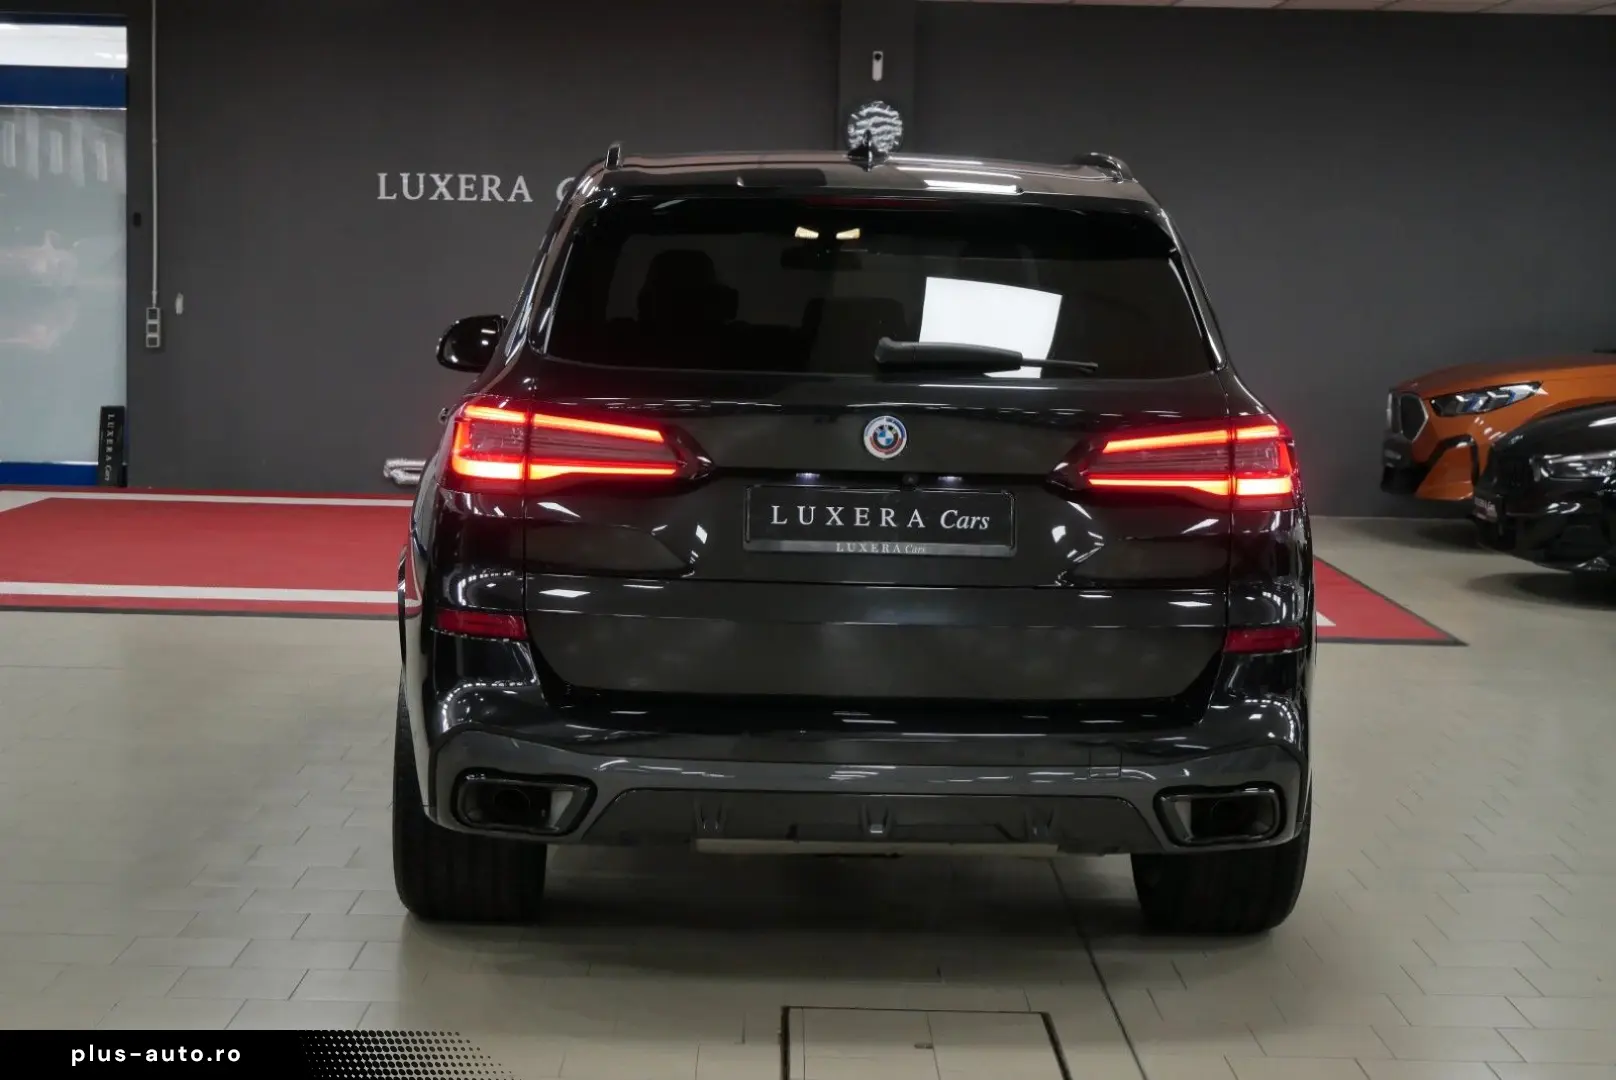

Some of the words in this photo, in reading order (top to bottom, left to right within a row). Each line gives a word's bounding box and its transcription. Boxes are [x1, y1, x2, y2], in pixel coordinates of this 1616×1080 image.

[377, 172, 533, 203] LUXERA
[105, 413, 116, 462] LUXERA
[770, 505, 926, 529] LUXERA
[940, 509, 990, 530] Cars
[835, 541, 901, 554] LUXERA
